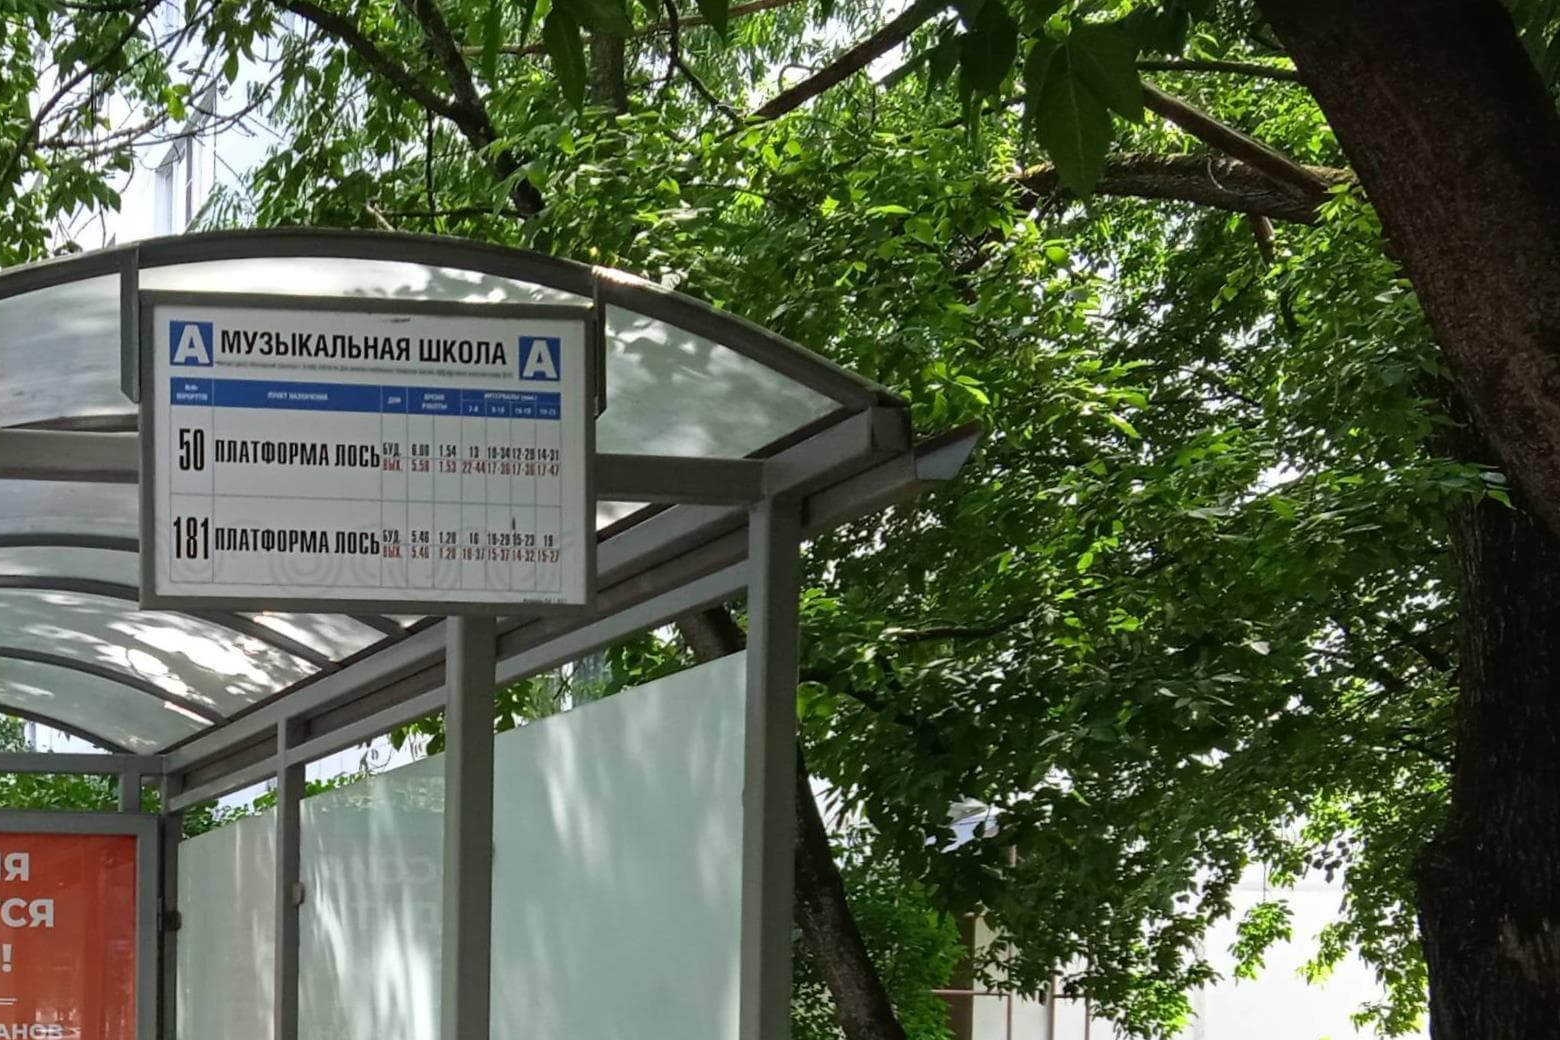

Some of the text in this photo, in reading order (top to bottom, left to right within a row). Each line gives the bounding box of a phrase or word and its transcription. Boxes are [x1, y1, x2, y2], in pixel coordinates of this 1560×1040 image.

[220, 329, 410, 362] МУЗЫКАЛЬНАЯ
[419, 338, 507, 365] ШКОЛА
[178, 427, 380, 471] 50 ПЛАТФОРМА ЛОСЬ
[173, 516, 380, 560] 181 ПЛАТФОРМА ЛОСЬ
